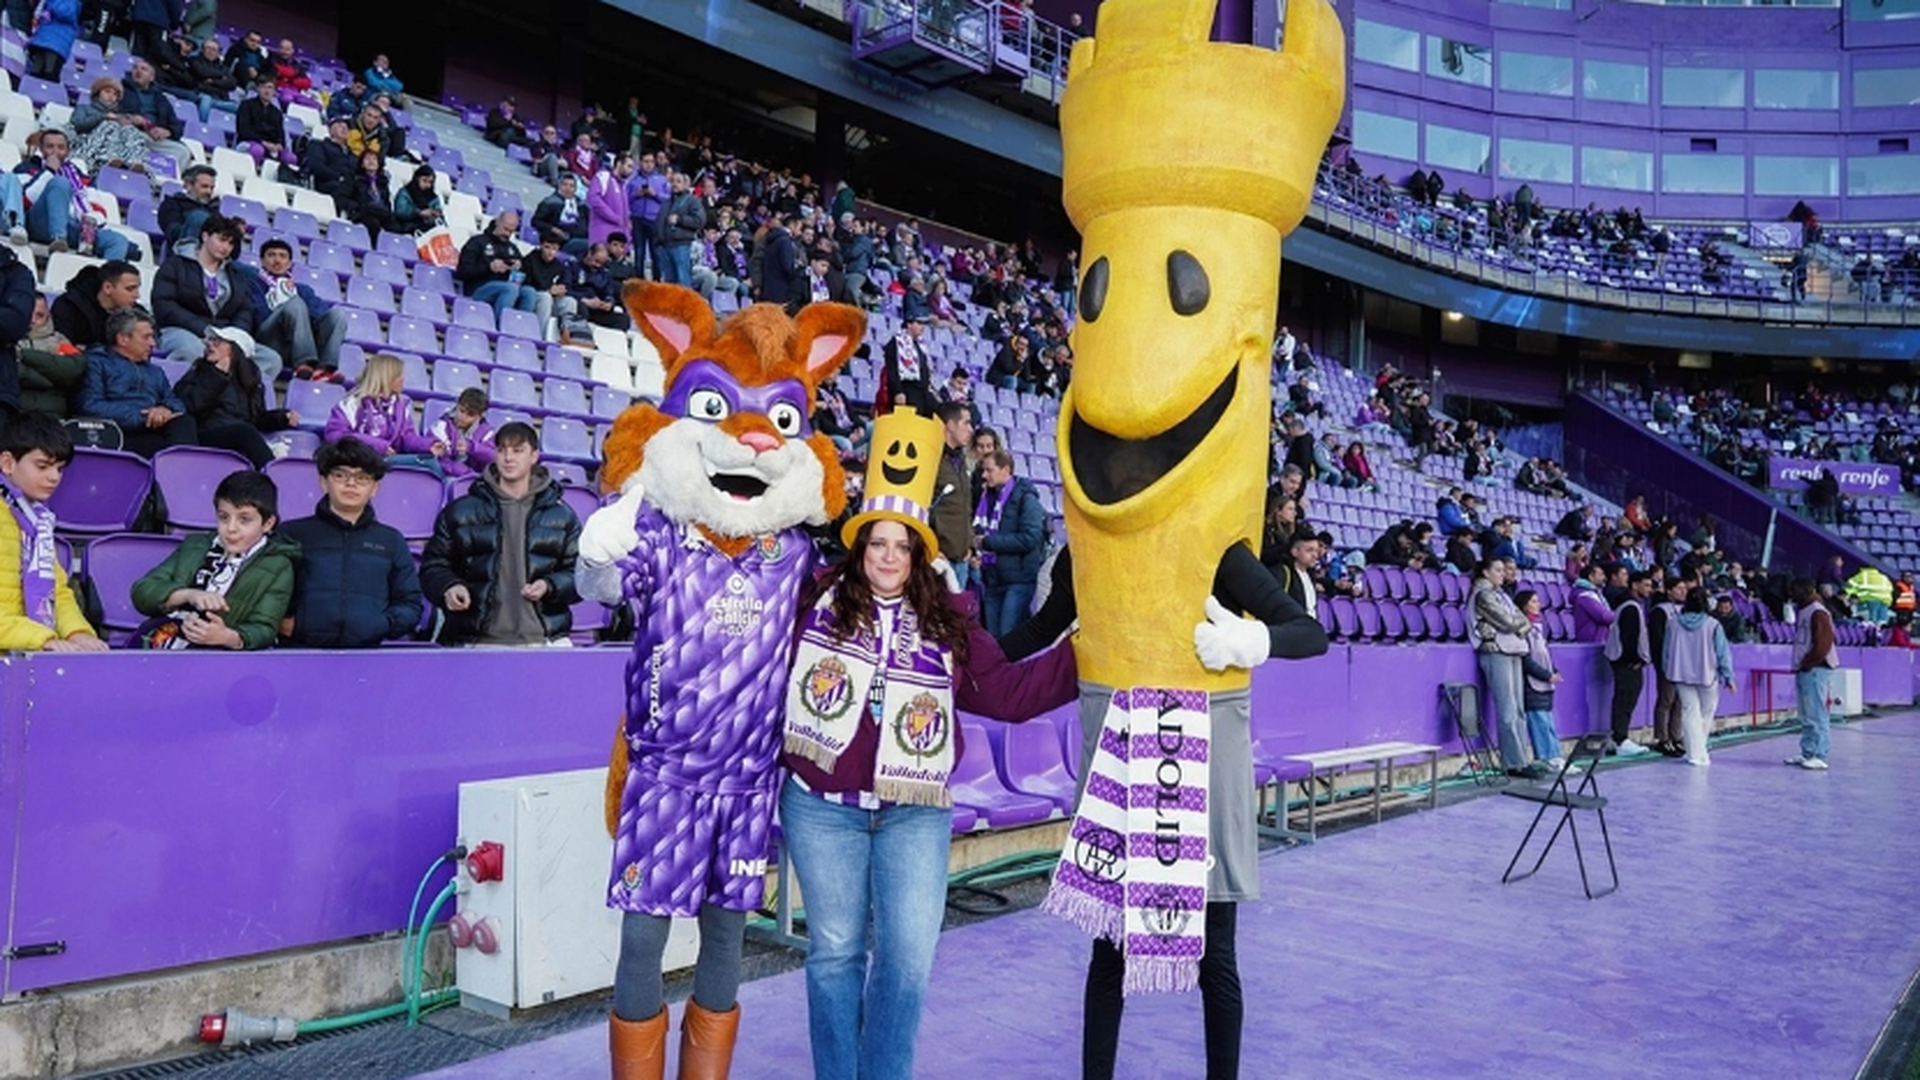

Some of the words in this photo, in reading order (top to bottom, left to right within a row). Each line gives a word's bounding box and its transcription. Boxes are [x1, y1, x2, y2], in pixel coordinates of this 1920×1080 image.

[1840, 468, 1890, 490] renfe
[712, 595, 763, 611] Estrella
[712, 608, 761, 626] Galicia
[788, 720, 845, 751] Valladolid
[880, 764, 948, 782] Valladoli
[1154, 688, 1183, 867] ADOLID
[729, 858, 768, 877] INE
